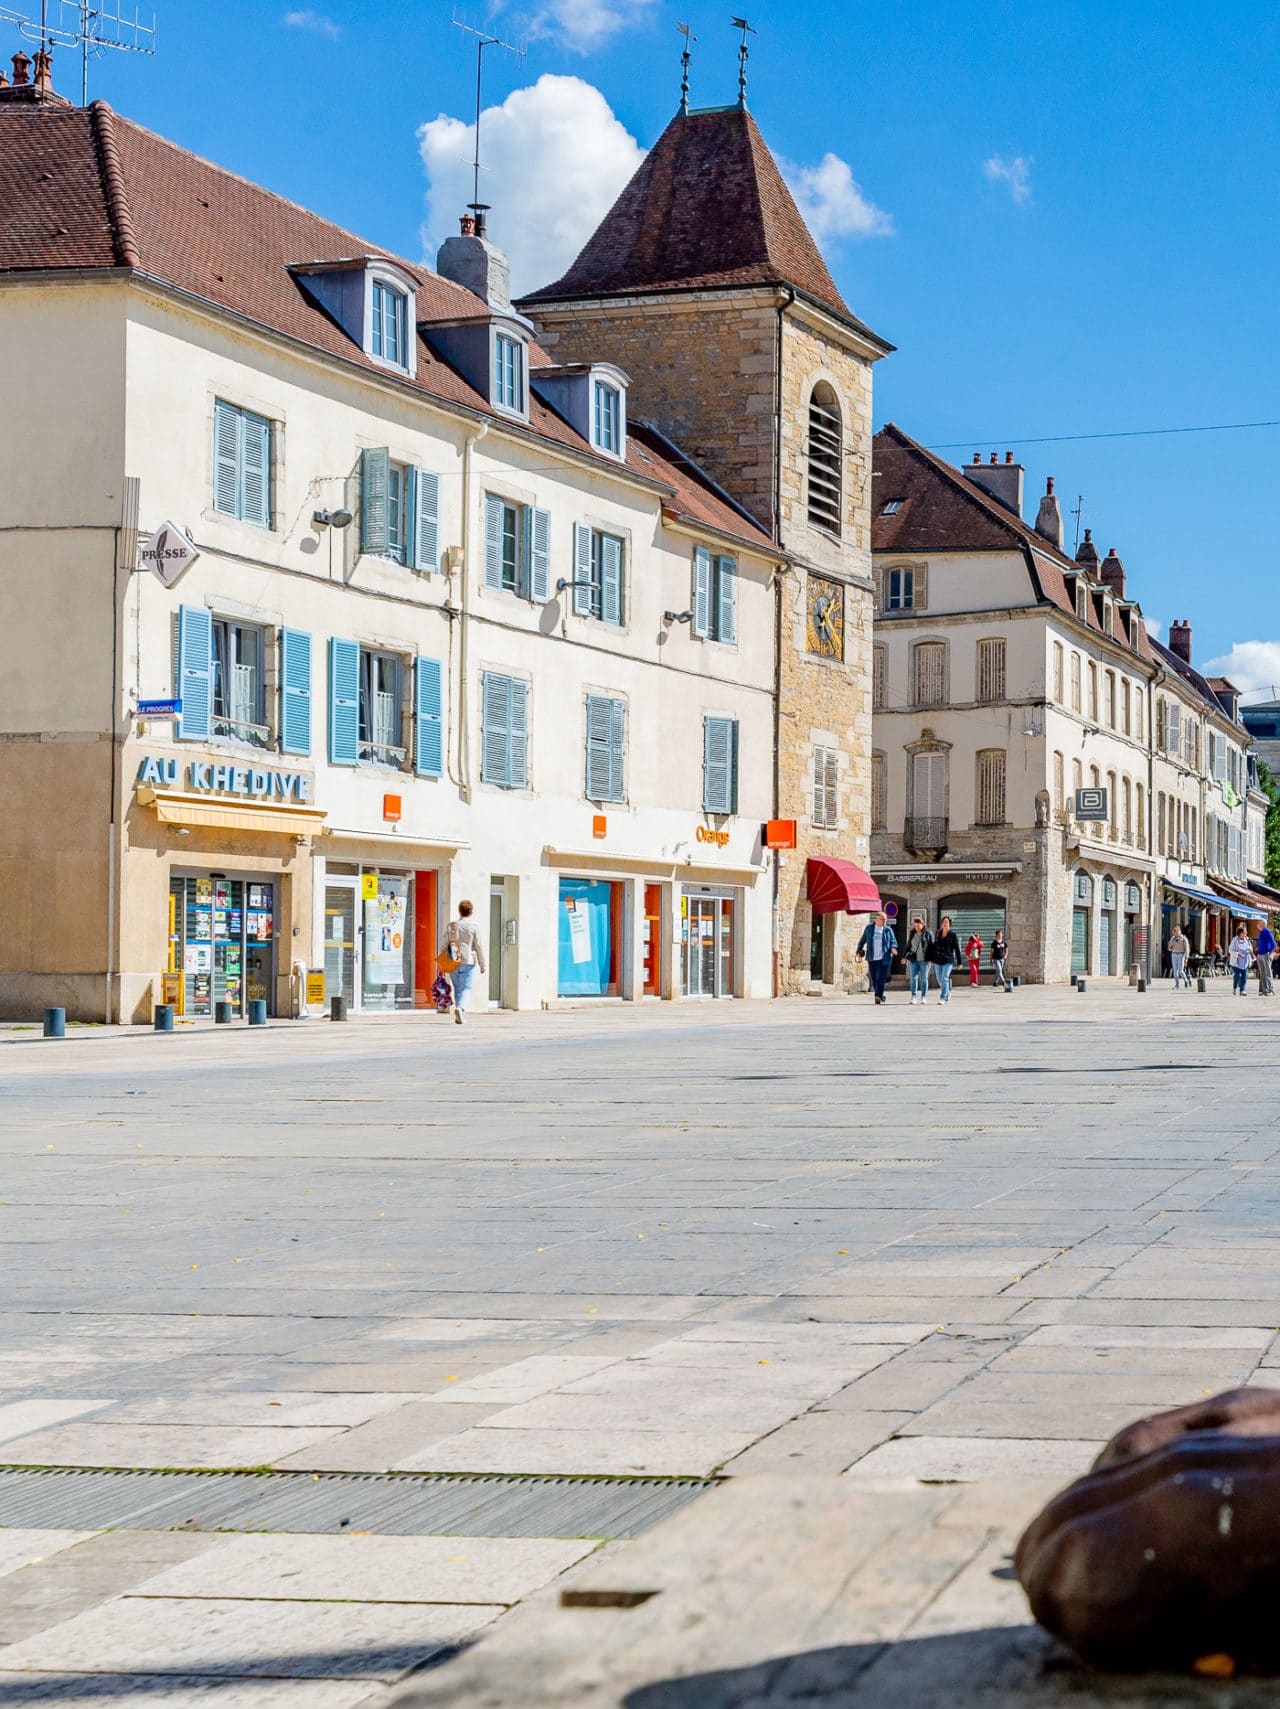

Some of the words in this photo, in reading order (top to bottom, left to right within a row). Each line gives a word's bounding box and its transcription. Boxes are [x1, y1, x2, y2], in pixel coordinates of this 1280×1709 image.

[142, 548, 187, 560] PRESSE
[141, 756, 179, 784] AU
[190, 762, 314, 801] KHEDIVE
[695, 825, 730, 848] Orange
[767, 840, 792, 848] orange
